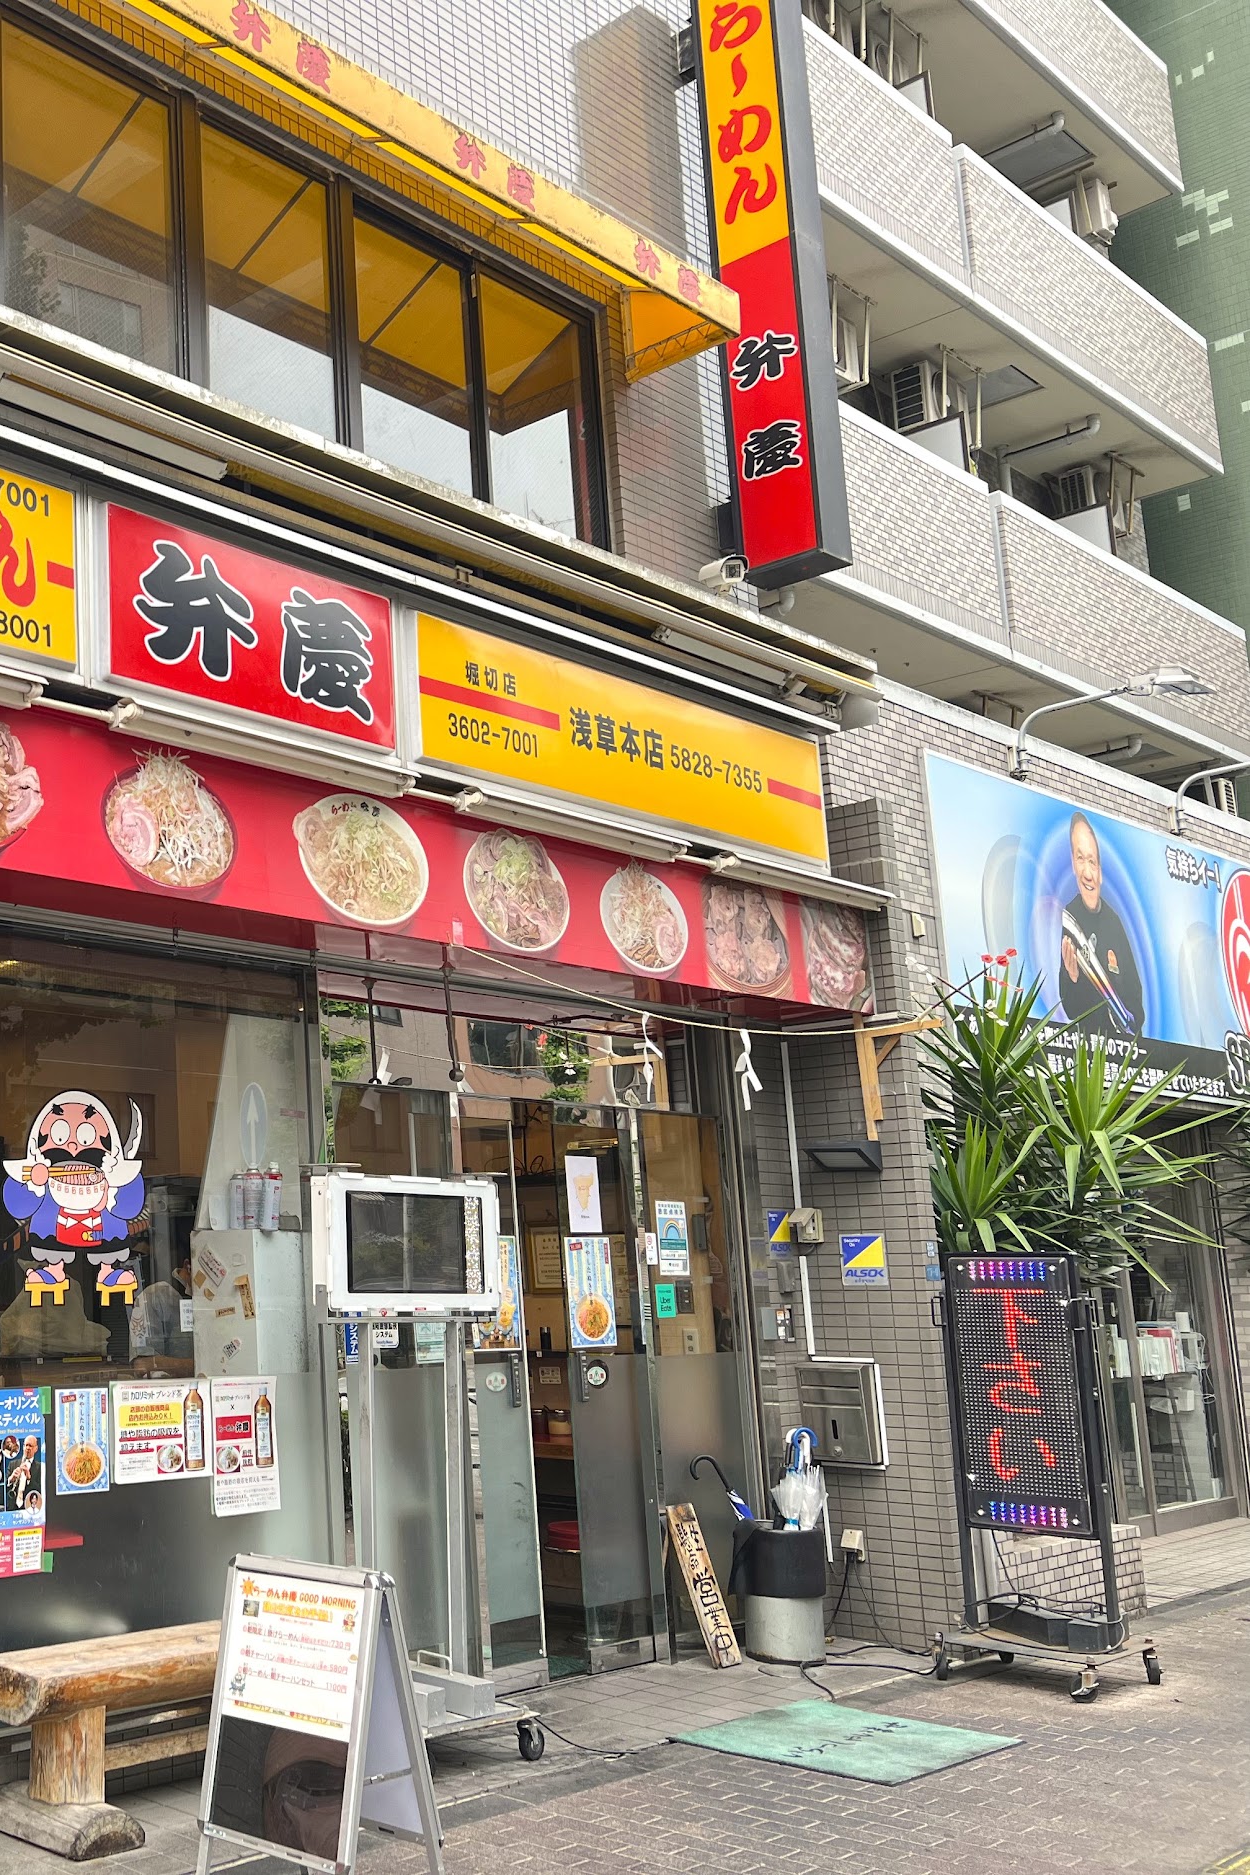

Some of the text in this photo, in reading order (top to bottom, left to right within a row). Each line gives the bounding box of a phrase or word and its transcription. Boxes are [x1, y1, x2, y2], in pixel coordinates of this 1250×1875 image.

[708, 0, 779, 225] らーめん
[729, 331, 801, 482] 弁慶
[135, 540, 373, 726] 弁慶
[464, 660, 518, 698] 堀切店
[447, 711, 539, 758] 3602-7001
[569, 706, 763, 794] 浅草本店 5828-7355
[845, 1268, 885, 1278] ALSOK
[299, 1592, 319, 1604] GOOD
[321, 1595, 357, 1609] MORNING
